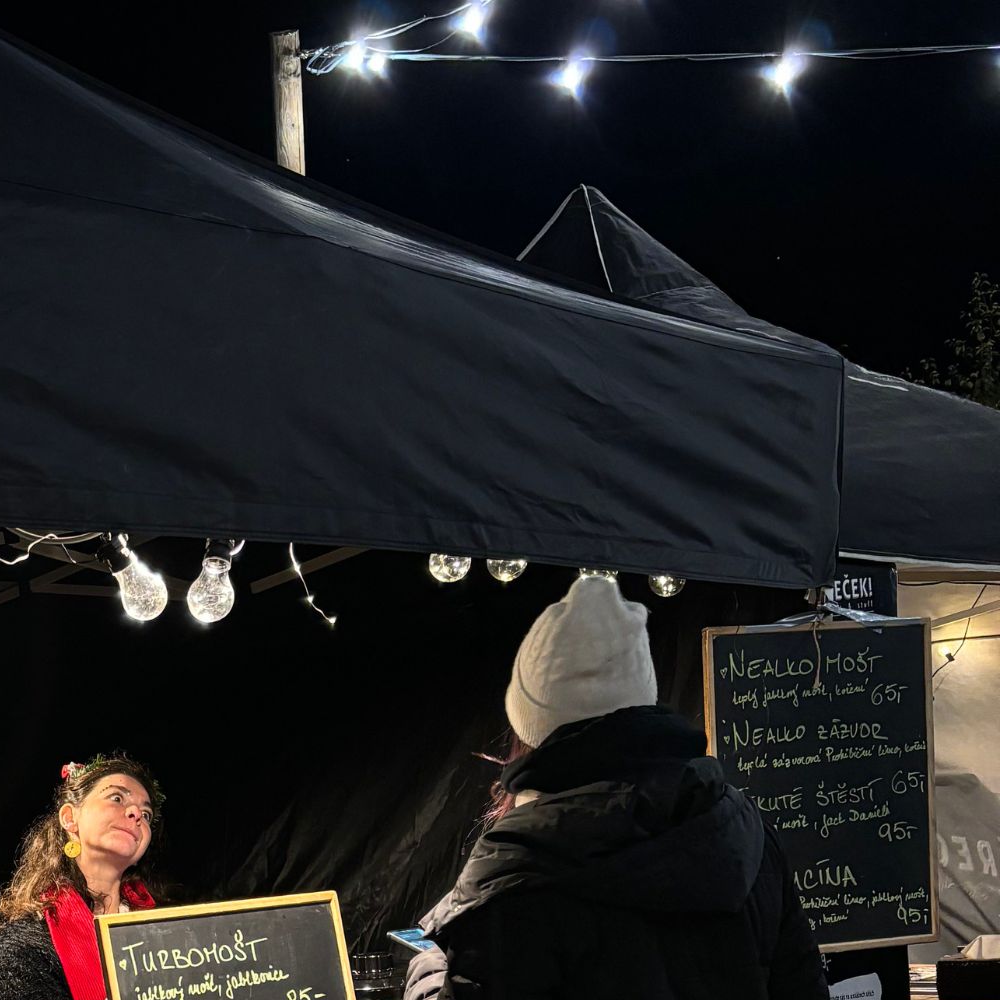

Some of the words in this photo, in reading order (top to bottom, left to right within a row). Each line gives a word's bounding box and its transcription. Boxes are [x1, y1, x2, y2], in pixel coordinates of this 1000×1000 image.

[728, 649, 814, 682] NEALKO
[826, 646, 884, 675] MOŠT
[732, 684, 759, 710] teplý
[733, 719, 807, 748] NEALKO
[818, 718, 889, 740] ZÁZVOR
[737, 752, 768, 776] teplá
[815, 777, 885, 807] ŠTĚSTÍ
[820, 812, 846, 839] Jack
[121, 928, 268, 976] TURBOMOŠT
[225, 964, 290, 1000] jablkovice
